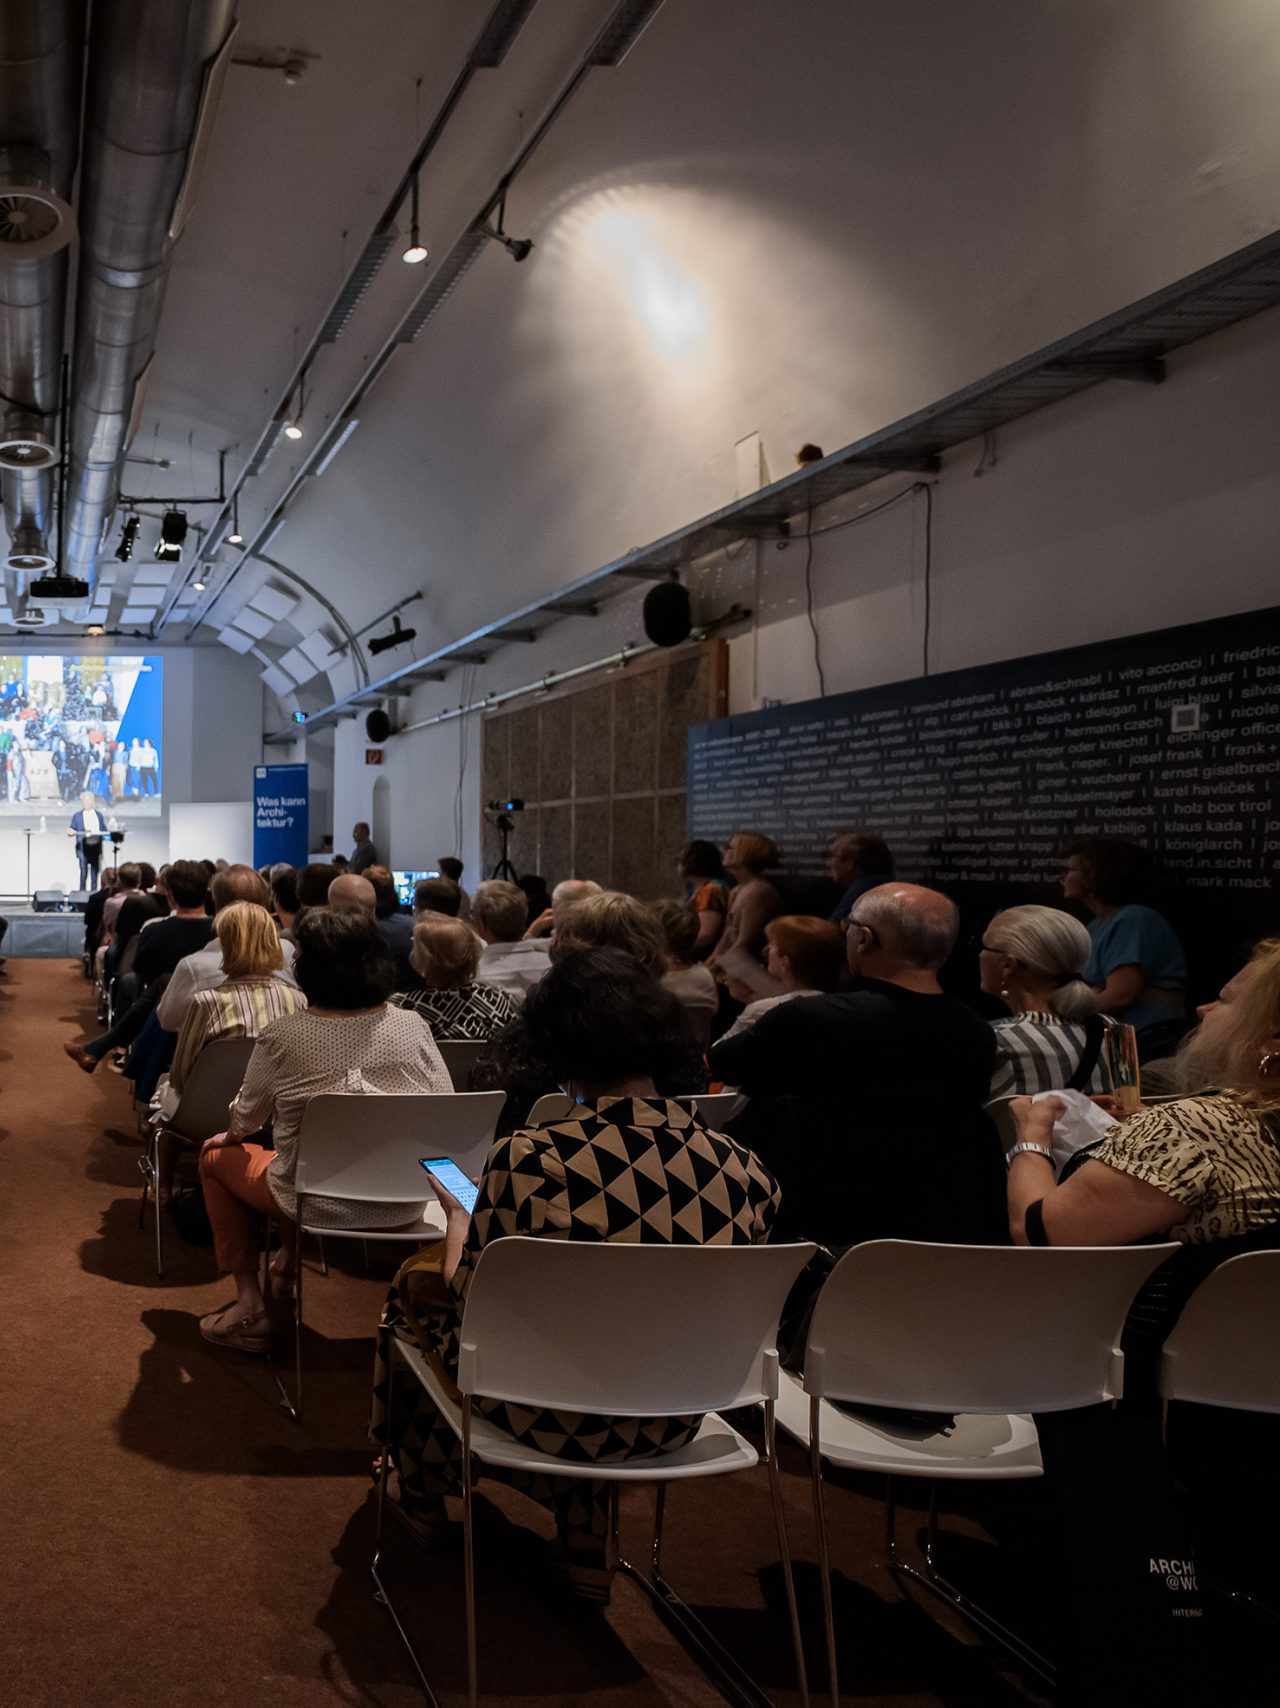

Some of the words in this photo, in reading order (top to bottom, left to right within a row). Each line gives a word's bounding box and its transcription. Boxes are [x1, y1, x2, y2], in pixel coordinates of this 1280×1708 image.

[1119, 668, 1143, 680] vito
[1146, 656, 1202, 676] acconci
[1024, 696, 1065, 711] auböck
[1137, 676, 1196, 695] manfred
[1200, 672, 1234, 686] auer
[1085, 704, 1136, 719] delugan
[1189, 692, 1220, 704] blau
[1064, 724, 1121, 738] hermann
[1124, 717, 1163, 731] czech
[1231, 702, 1280, 718] nicole
[1012, 745, 1065, 759] eichinger
[1068, 742, 1096, 754] oder
[1100, 736, 1148, 750] knechtl
[1129, 750, 1162, 767] josef
[1167, 748, 1203, 761] frank
[1225, 742, 1265, 756] frank
[1270, 744, 1277, 752] +
[1081, 772, 1142, 785] wucherer
[1161, 766, 1199, 780] ernst
[257, 797, 279, 806] Was
[282, 797, 305, 806] kann
[1028, 794, 1052, 804] otto
[1154, 784, 1188, 798] karel
[257, 808, 287, 816] Archi-
[1095, 804, 1155, 817] holodeck
[1174, 802, 1203, 815] holz
[1208, 801, 1236, 813] box
[1240, 799, 1272, 812] tirol
[257, 818, 294, 827] tektur?
[1164, 820, 1202, 832] klaus
[1206, 819, 1243, 832] kada
[1165, 838, 1242, 853] königlarch
[1187, 875, 1224, 887] mark
[1229, 876, 1272, 888] mack
